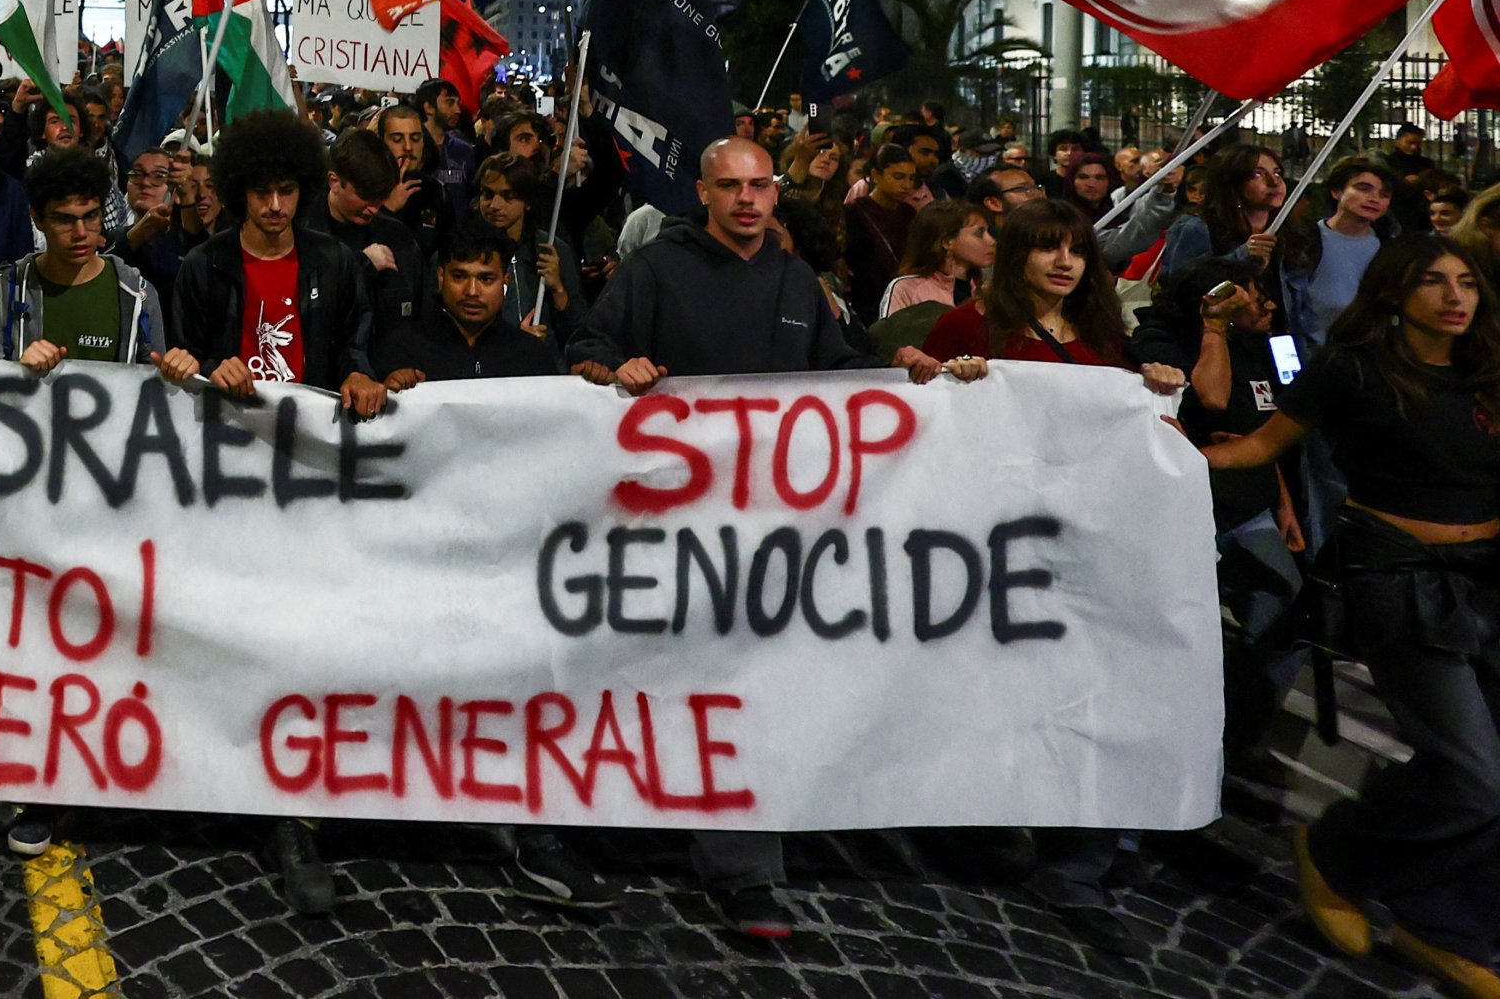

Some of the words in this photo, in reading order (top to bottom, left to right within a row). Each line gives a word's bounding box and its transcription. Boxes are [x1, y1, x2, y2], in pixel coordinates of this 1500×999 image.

[297, 36, 433, 80] CRISTIANA
[611, 388, 918, 516] STOP
[536, 514, 1070, 644] GENOCIDE
[259, 688, 756, 814] GENERALE
